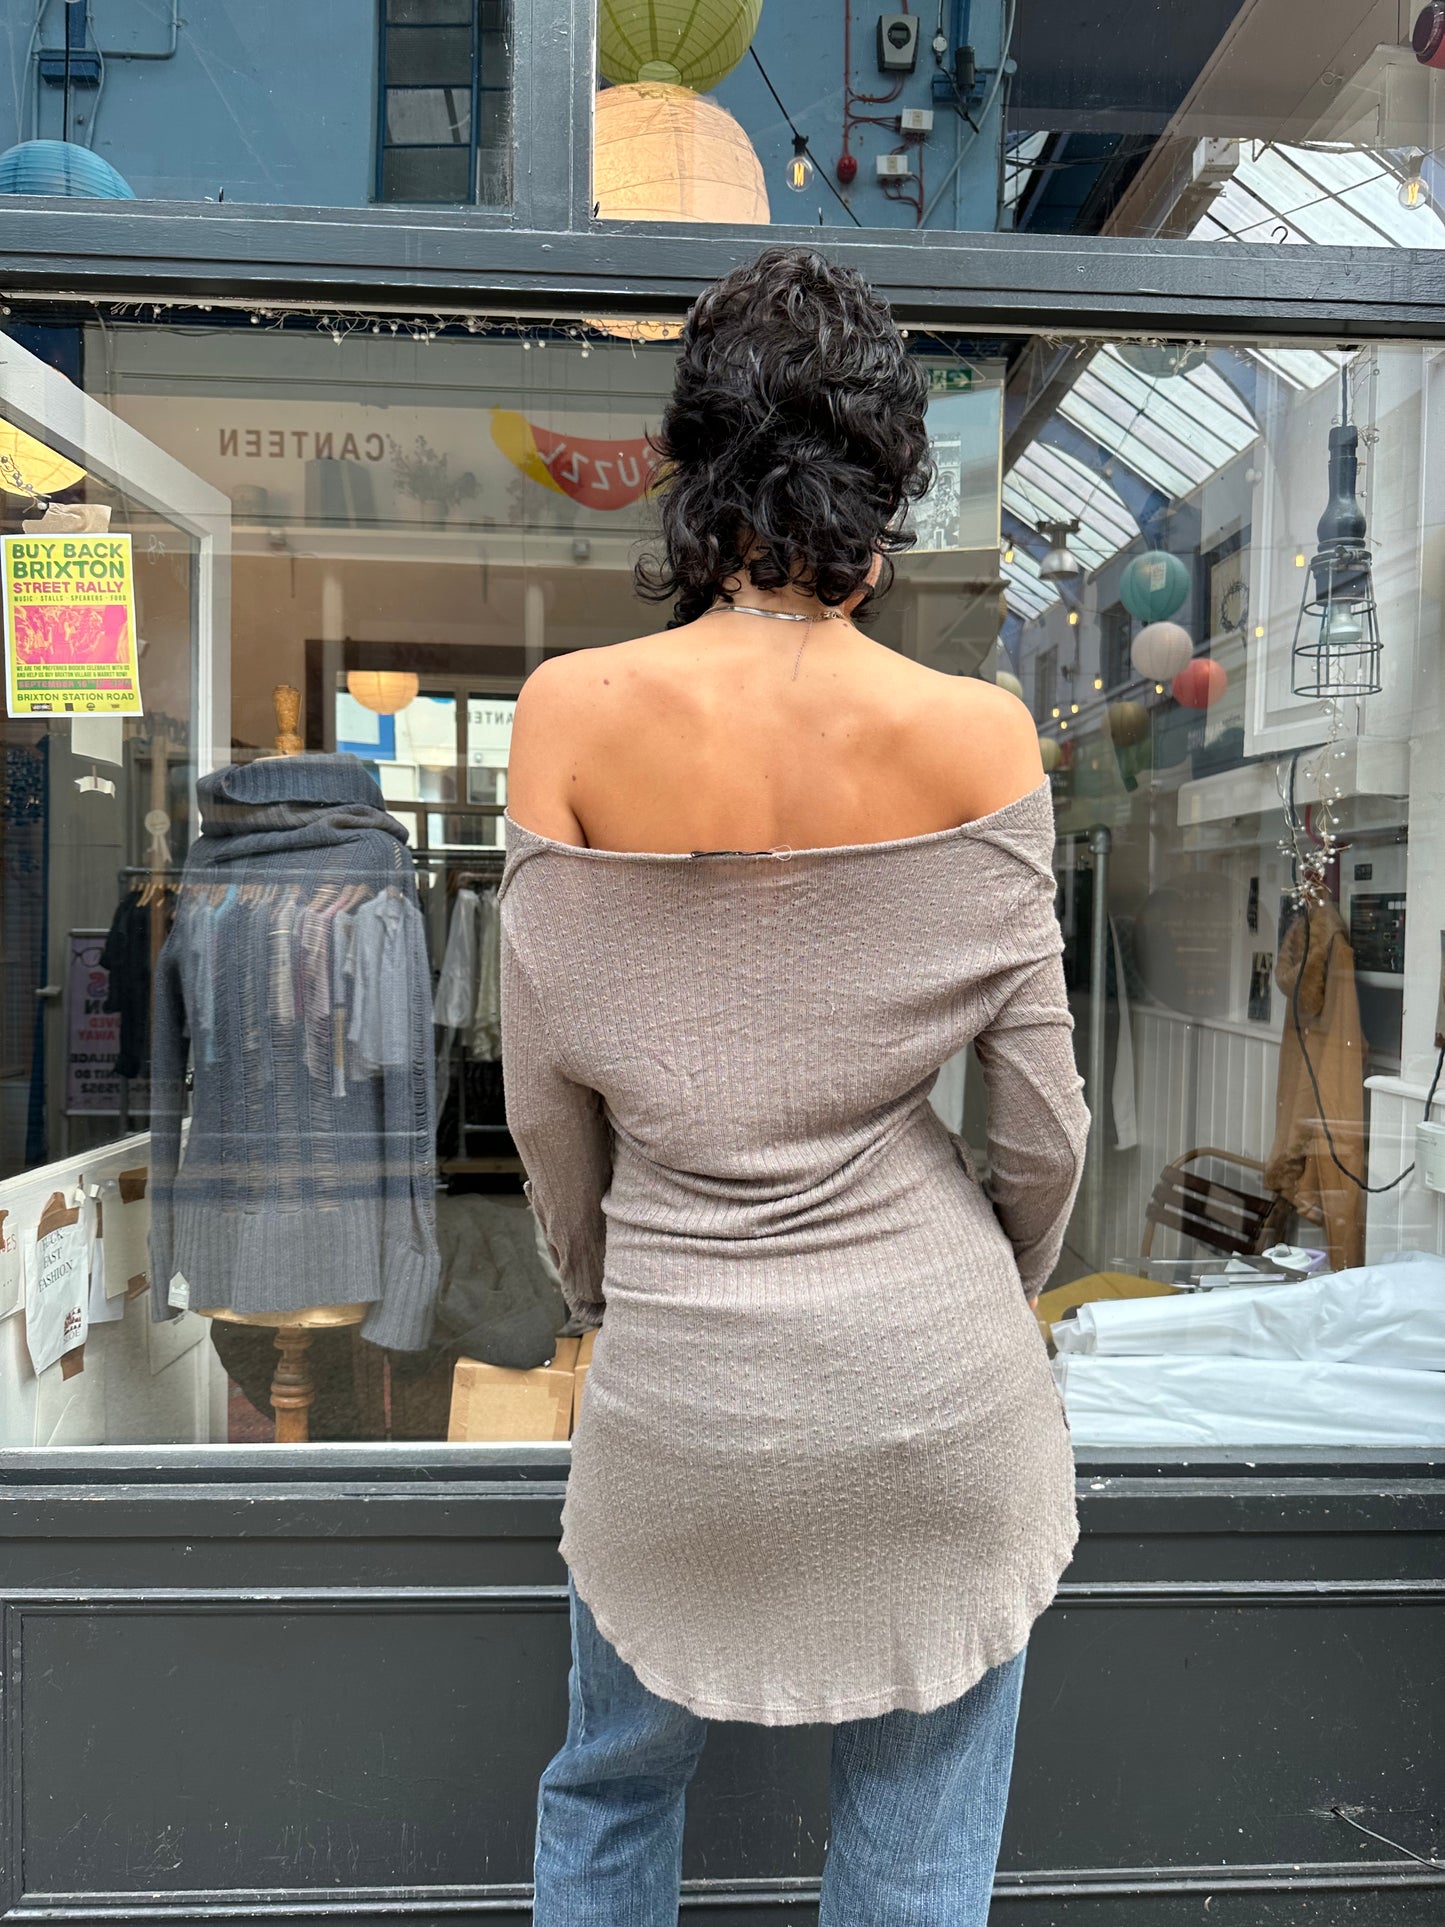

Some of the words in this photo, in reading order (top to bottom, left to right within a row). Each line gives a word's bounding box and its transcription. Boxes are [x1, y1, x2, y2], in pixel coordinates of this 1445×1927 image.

[12, 543, 56, 559] BUY
[63, 542, 124, 559] BACK
[13, 559, 125, 579] BRIXTON
[13, 581, 71, 594] STREET
[75, 581, 124, 593] RALLY
[70, 594, 103, 602] SPEAKERS
[18, 681, 75, 689] SEPTEMBER
[17, 693, 59, 701] BRIXTON
[62, 693, 104, 701] STATION
[107, 692, 135, 701] ROAD
